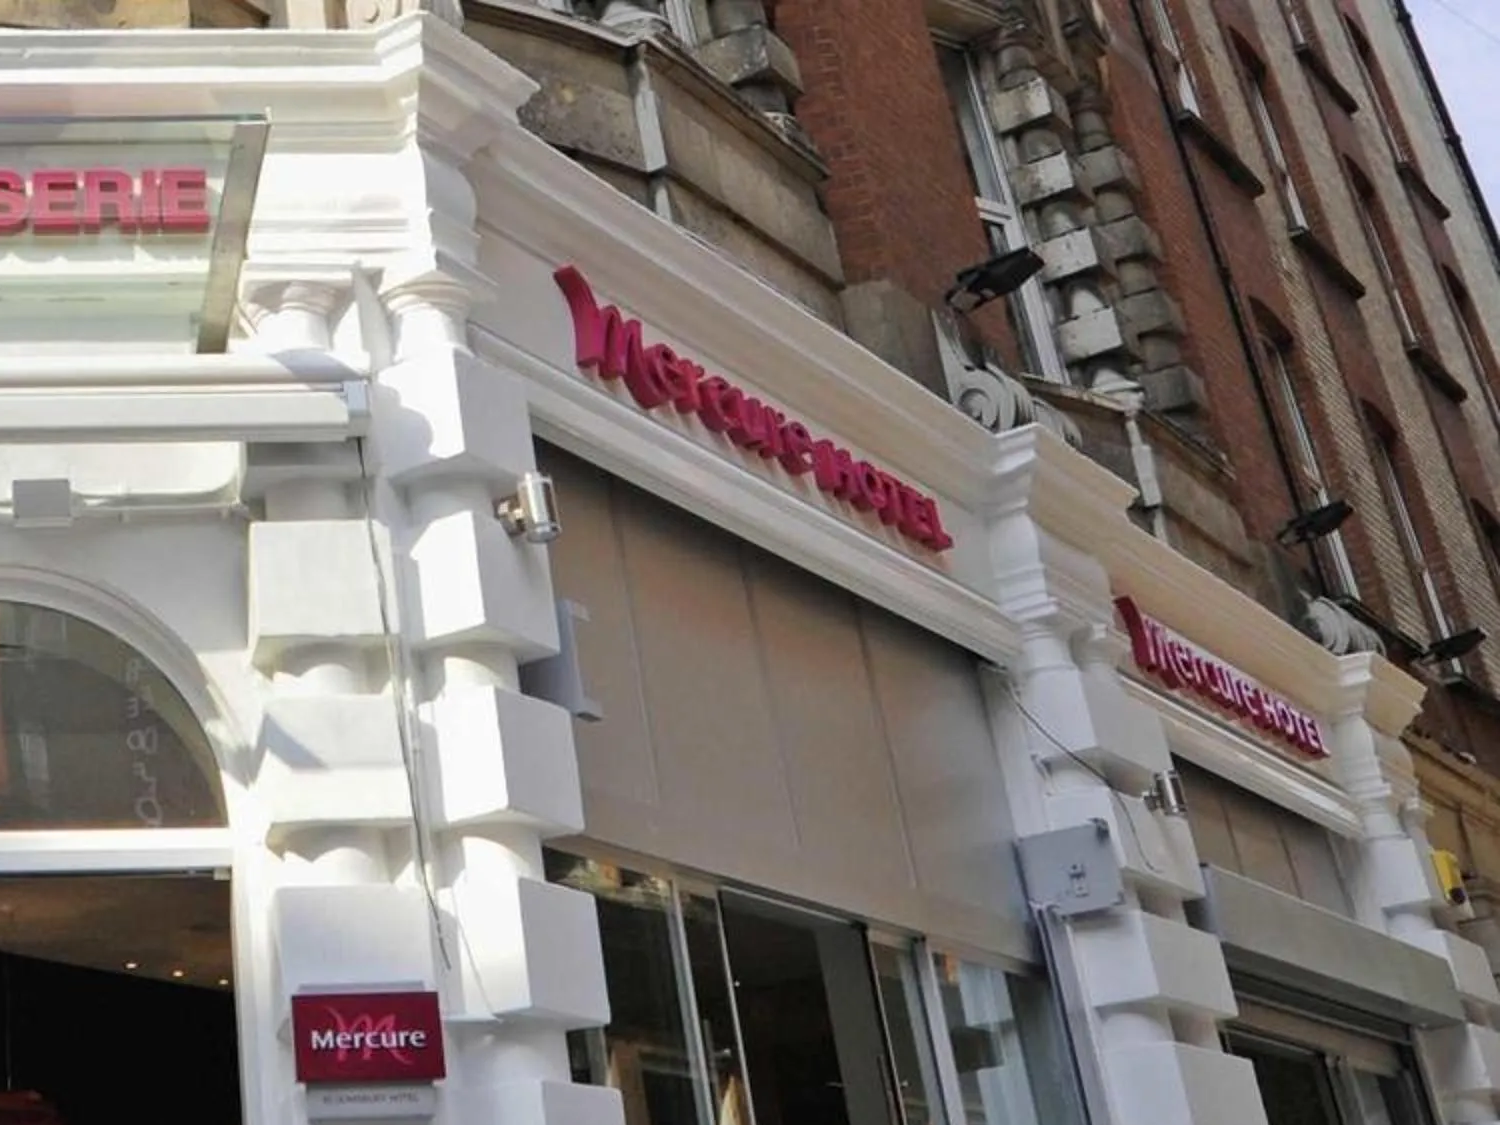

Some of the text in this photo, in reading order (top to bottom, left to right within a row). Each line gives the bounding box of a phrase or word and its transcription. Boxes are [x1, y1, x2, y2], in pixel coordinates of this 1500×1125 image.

[811, 438, 954, 552] HOTEL
[1256, 690, 1331, 758] HOTEL
[310, 1029, 427, 1050] Mercure
